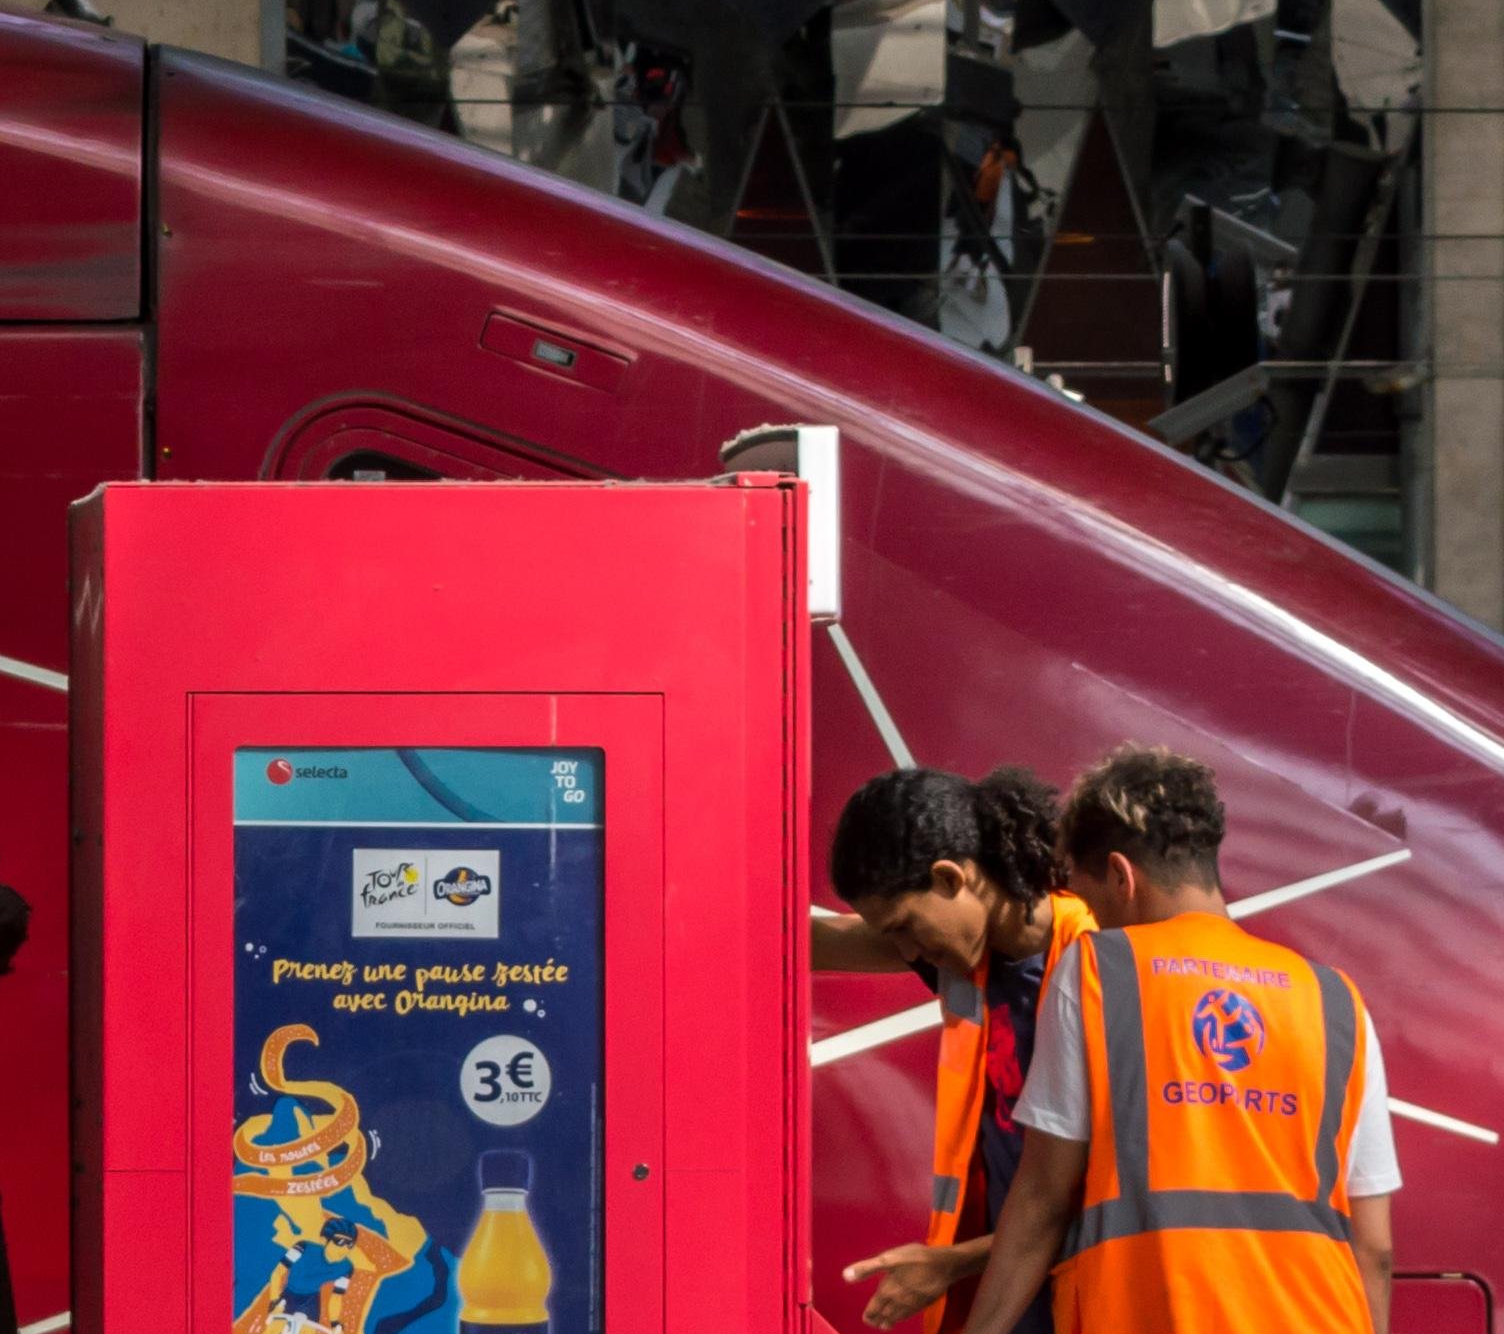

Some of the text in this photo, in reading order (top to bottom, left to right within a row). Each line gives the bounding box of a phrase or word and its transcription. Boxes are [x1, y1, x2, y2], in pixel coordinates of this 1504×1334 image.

[295, 766, 348, 779] selecta
[551, 761, 578, 774] JOY
[555, 776, 576, 788] TO
[563, 790, 585, 803] GO
[272, 957, 569, 992] Prenez une pause zestée
[1152, 958, 1290, 987] PARTENAIRE
[332, 989, 511, 1017] avec Orangina
[1163, 1082, 1297, 1115] GEOPRTS
